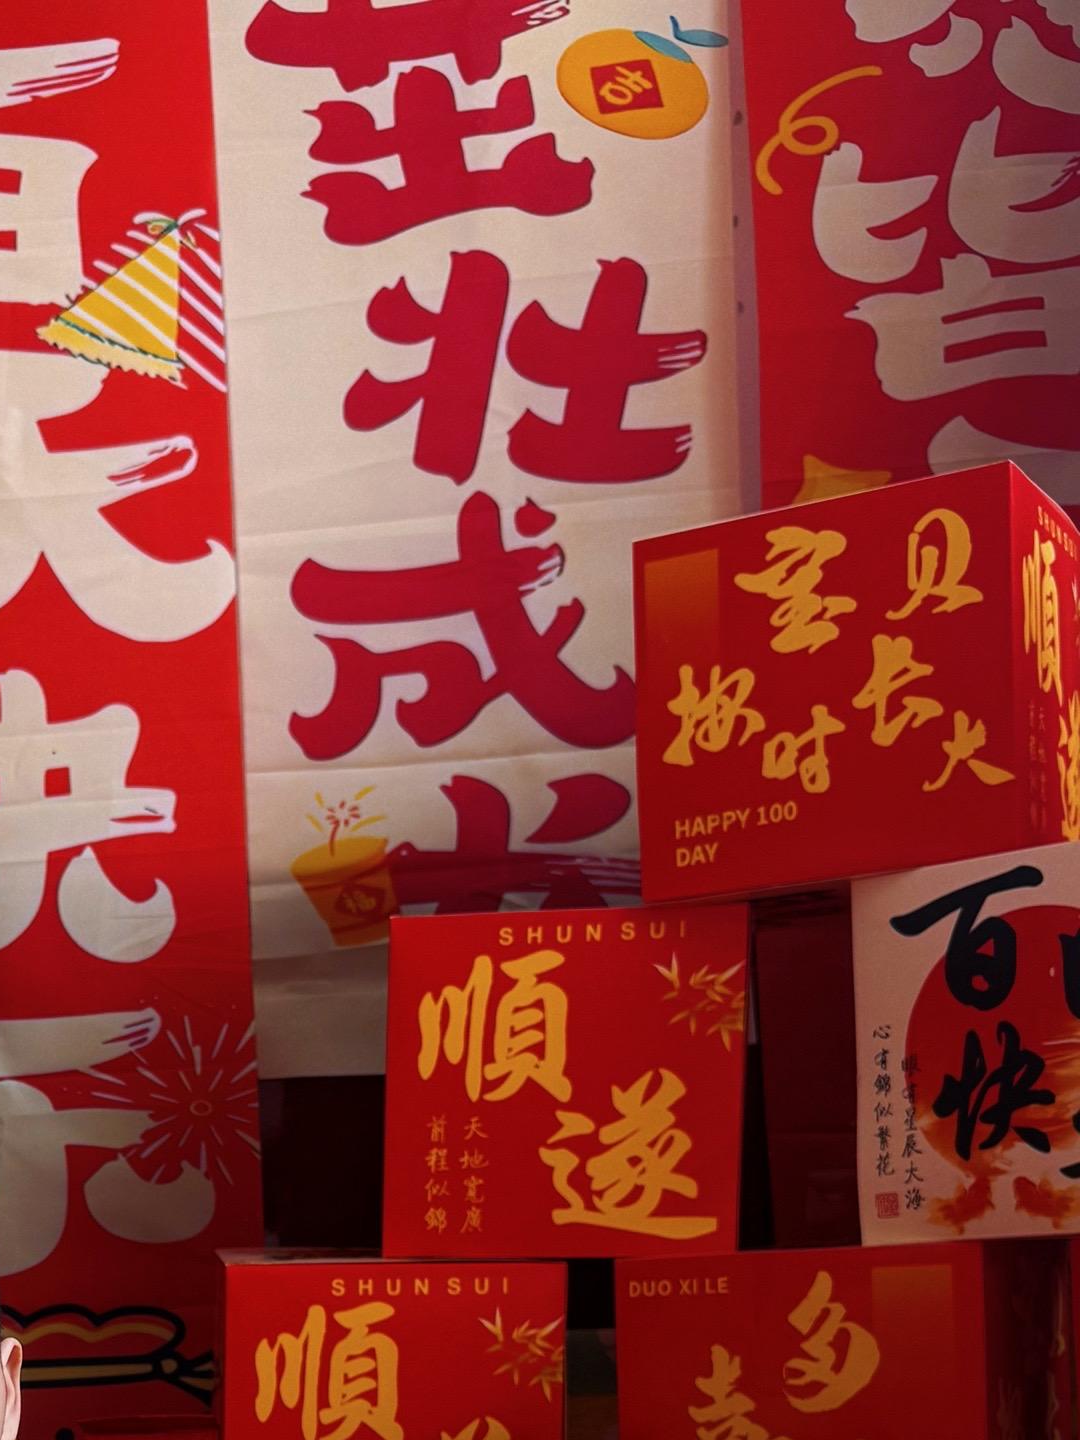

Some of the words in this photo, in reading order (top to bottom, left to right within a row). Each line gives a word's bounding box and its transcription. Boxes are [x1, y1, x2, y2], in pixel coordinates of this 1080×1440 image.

[675, 808, 751, 840] HAPPY
[756, 801, 798, 827] 100
[675, 842, 718, 868] DAY
[498, 923, 603, 946] SHUN
[620, 919, 686, 940] SUI
[331, 1278, 429, 1297] SHUN
[447, 1276, 509, 1295] SUI
[628, 1279, 672, 1298] DUO
[678, 1278, 699, 1295] XI
[704, 1276, 730, 1294] LE
